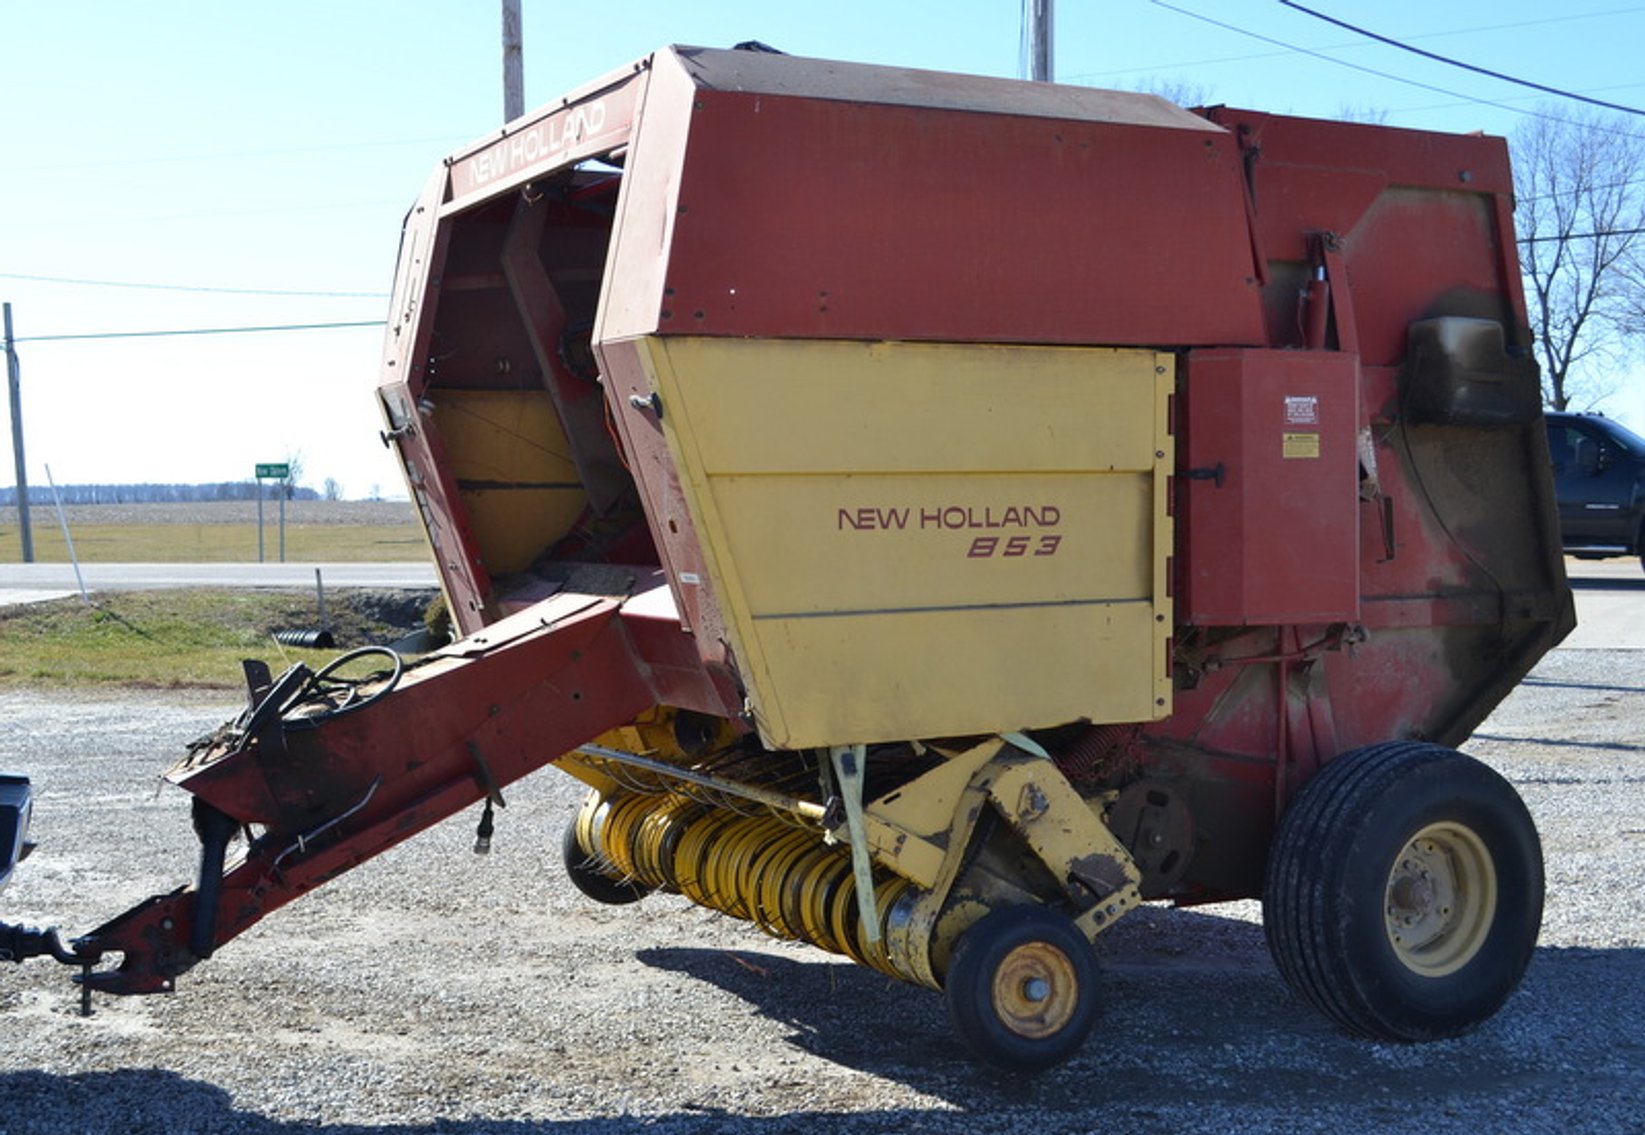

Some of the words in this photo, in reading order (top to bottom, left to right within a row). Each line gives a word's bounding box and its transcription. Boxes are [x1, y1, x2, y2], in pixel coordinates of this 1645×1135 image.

[469, 142, 509, 187] NEW
[511, 101, 606, 169] HOLLAND
[838, 508, 910, 530] NEW
[920, 506, 1061, 529] HOLLAND
[967, 535, 1062, 558] 853
